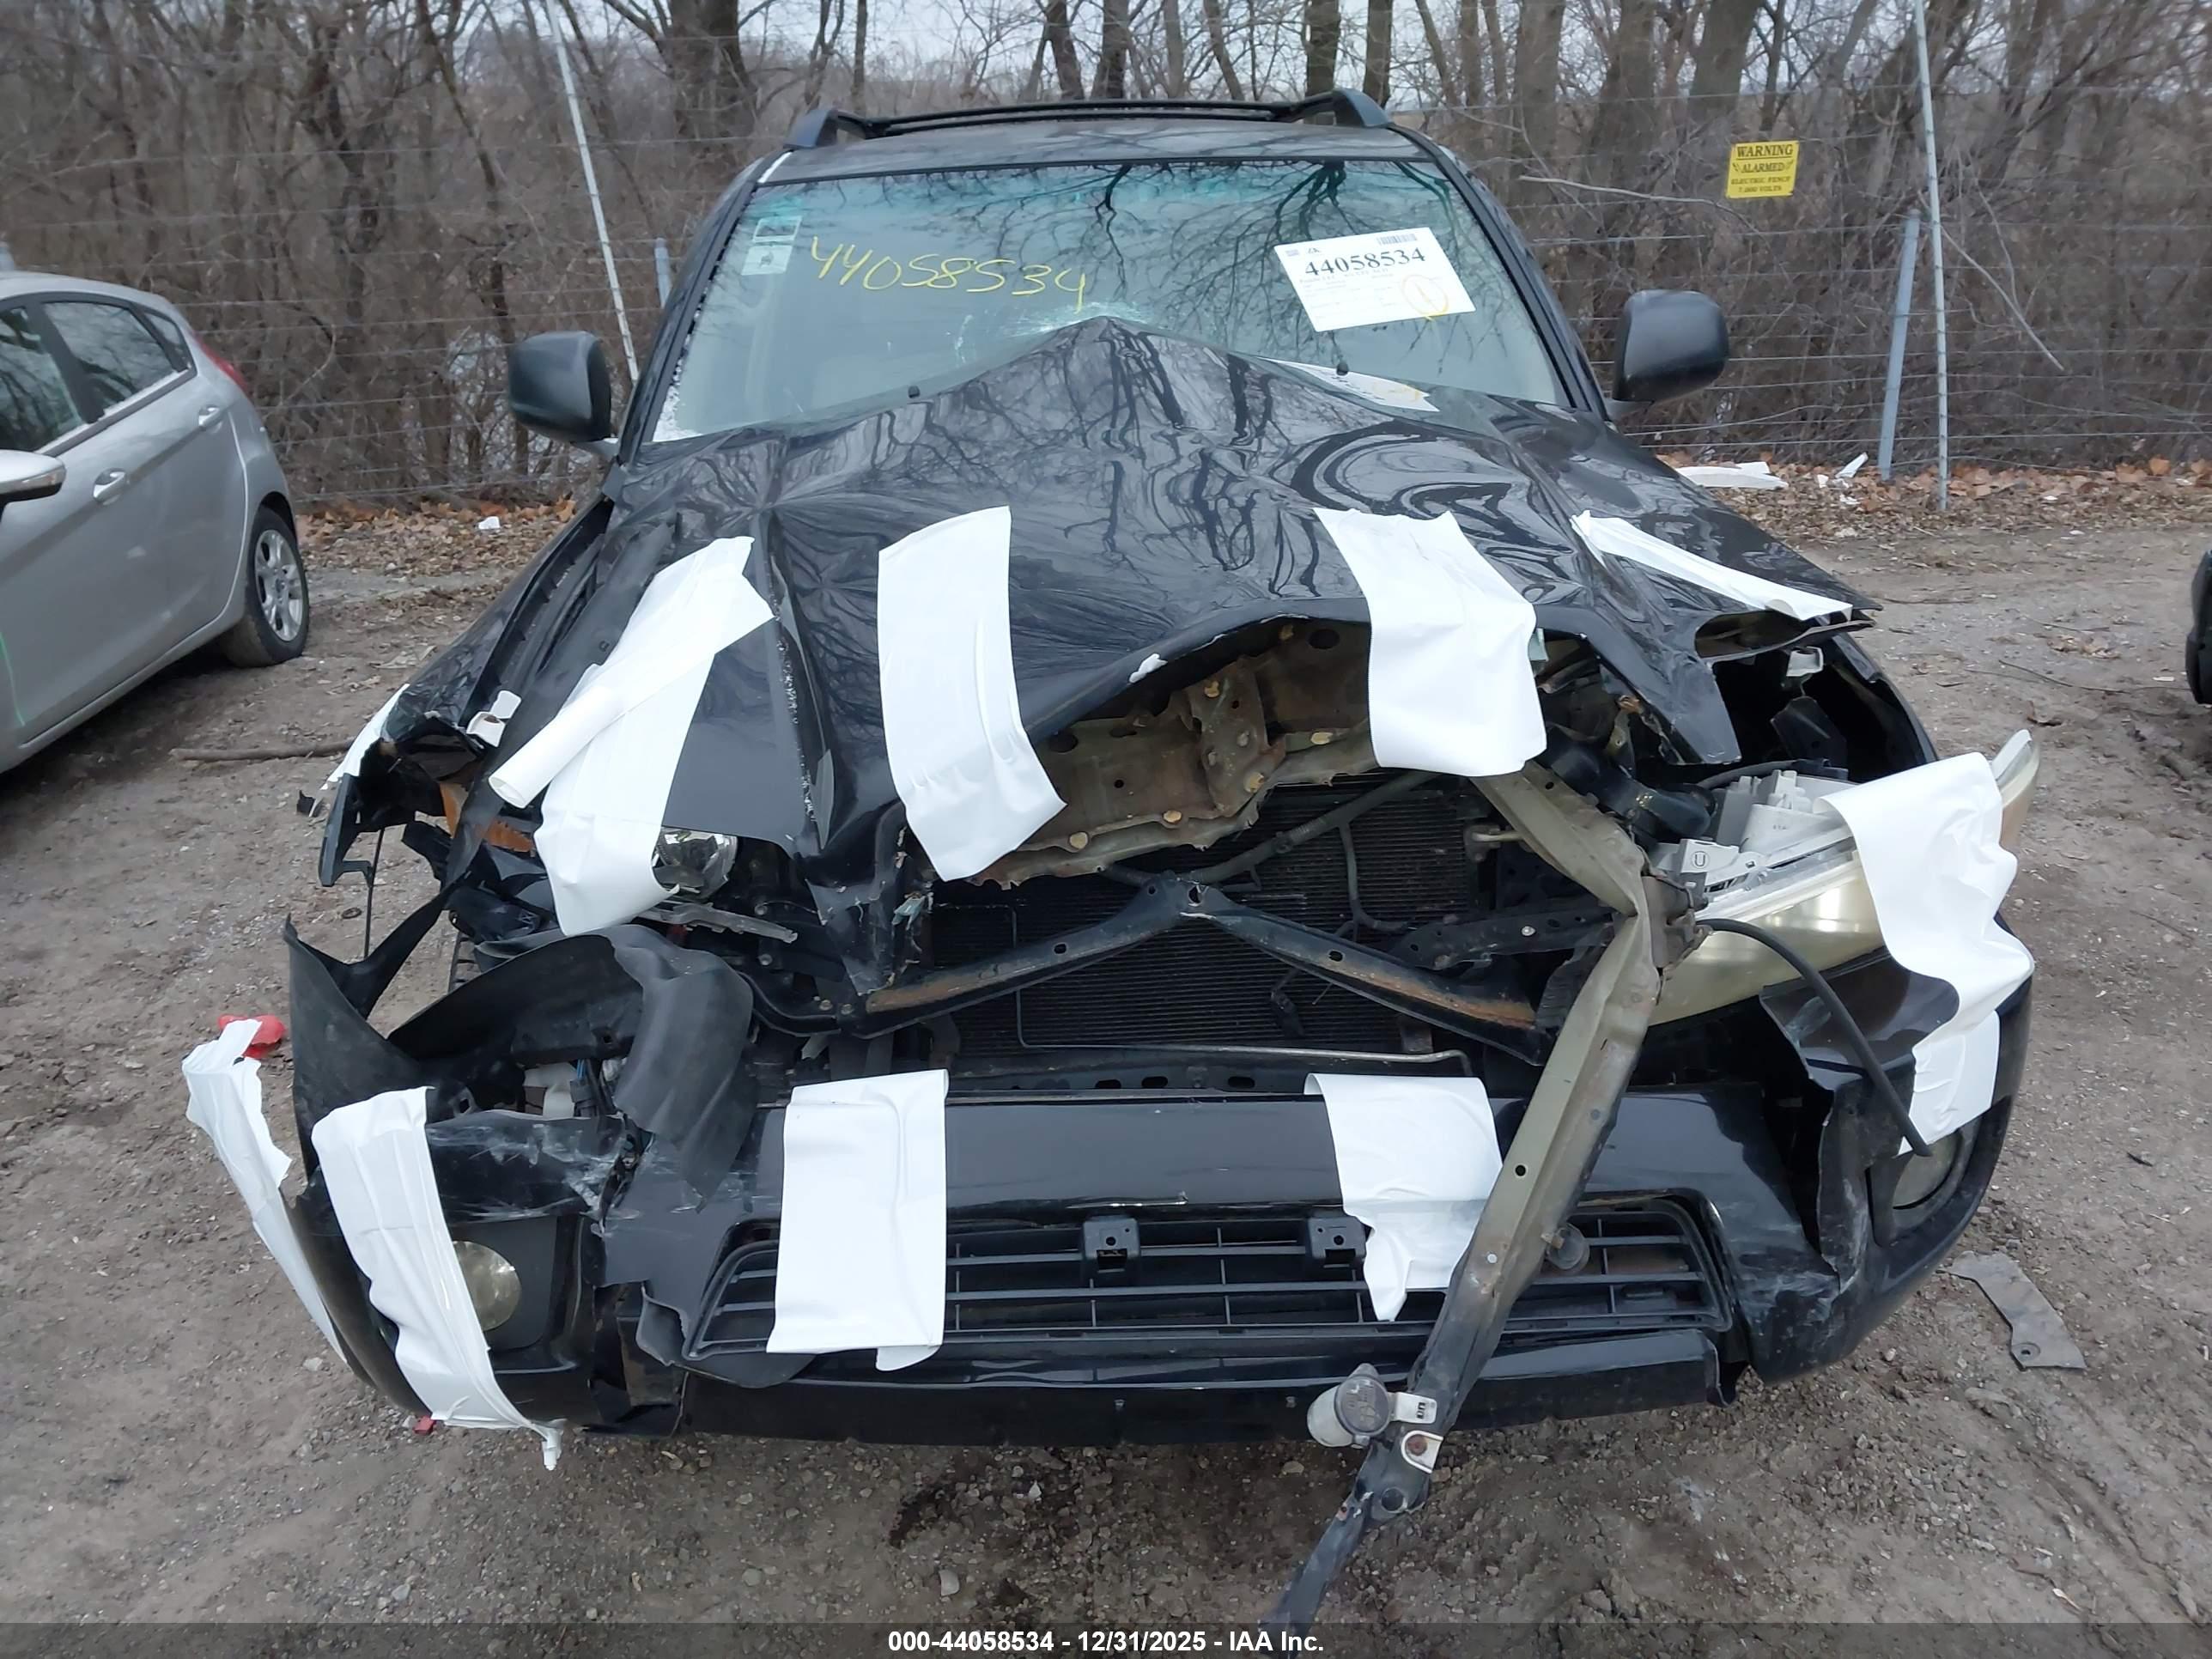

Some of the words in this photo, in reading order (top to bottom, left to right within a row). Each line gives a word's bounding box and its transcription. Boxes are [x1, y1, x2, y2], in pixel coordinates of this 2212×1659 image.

[1736, 144, 1794, 157] WARNING
[1741, 162, 1785, 173] ALARMED
[1304, 246, 1426, 276] 44058534
[810, 235, 1086, 315] 44058534
